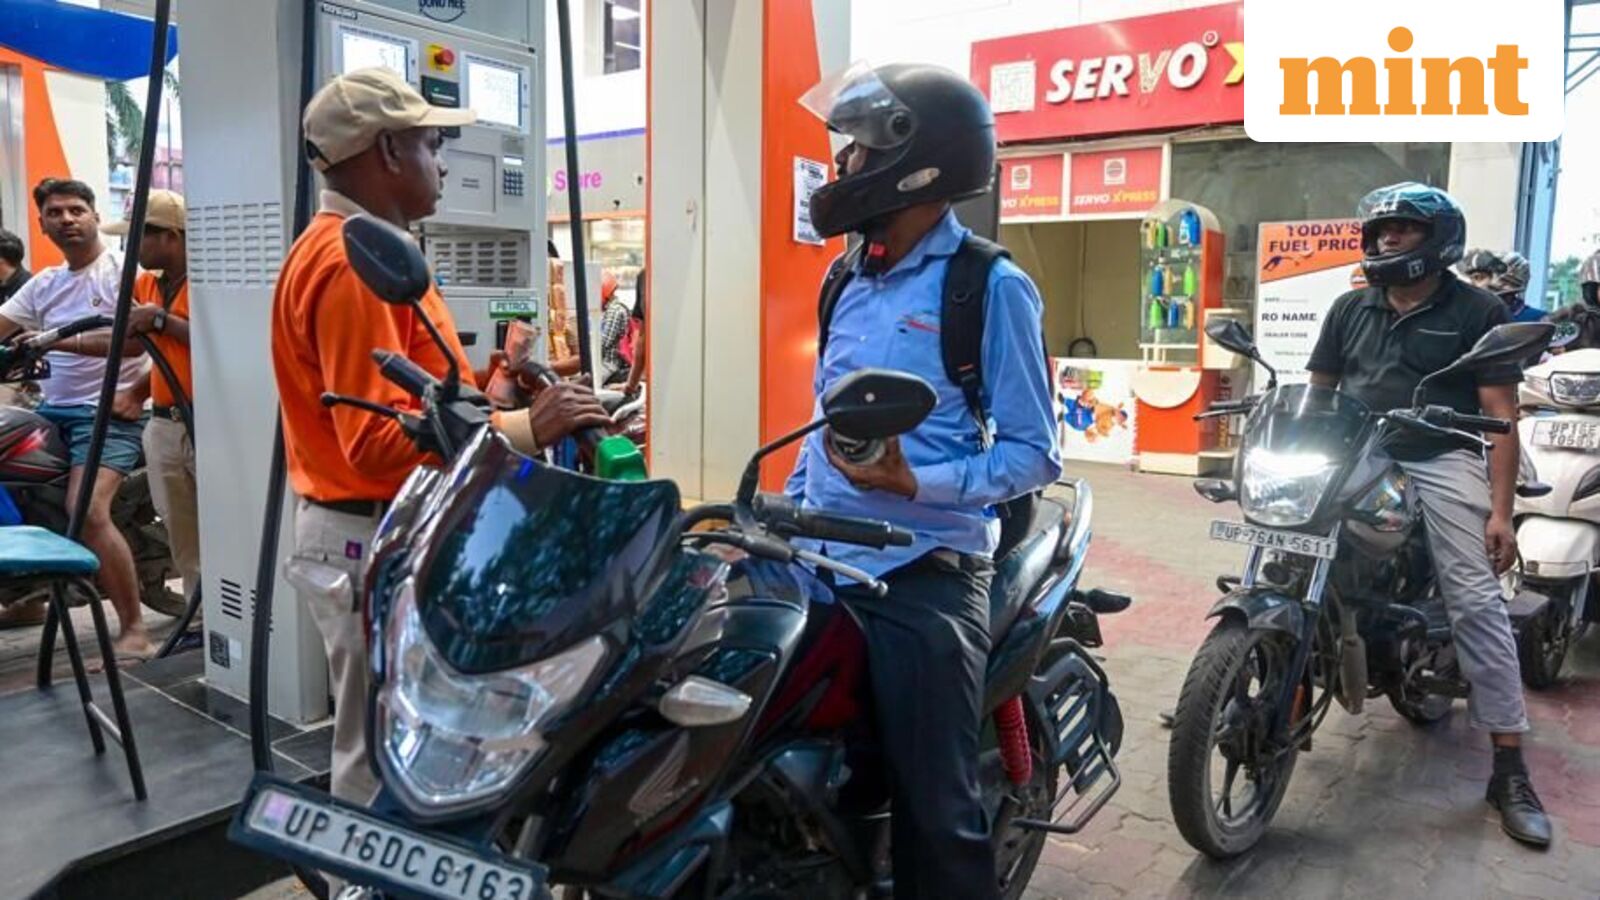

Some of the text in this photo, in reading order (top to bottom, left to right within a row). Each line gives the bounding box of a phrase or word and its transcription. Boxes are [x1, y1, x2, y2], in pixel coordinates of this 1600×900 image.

[1046, 41, 1209, 104] SERVO
[554, 170, 603, 192] Sre
[1073, 194, 1110, 207] SERVO
[1270, 238, 1366, 252] FUEL PRIC
[1262, 313, 1317, 321] RO NAME
[285, 805, 526, 900] UP 16DC 6163
